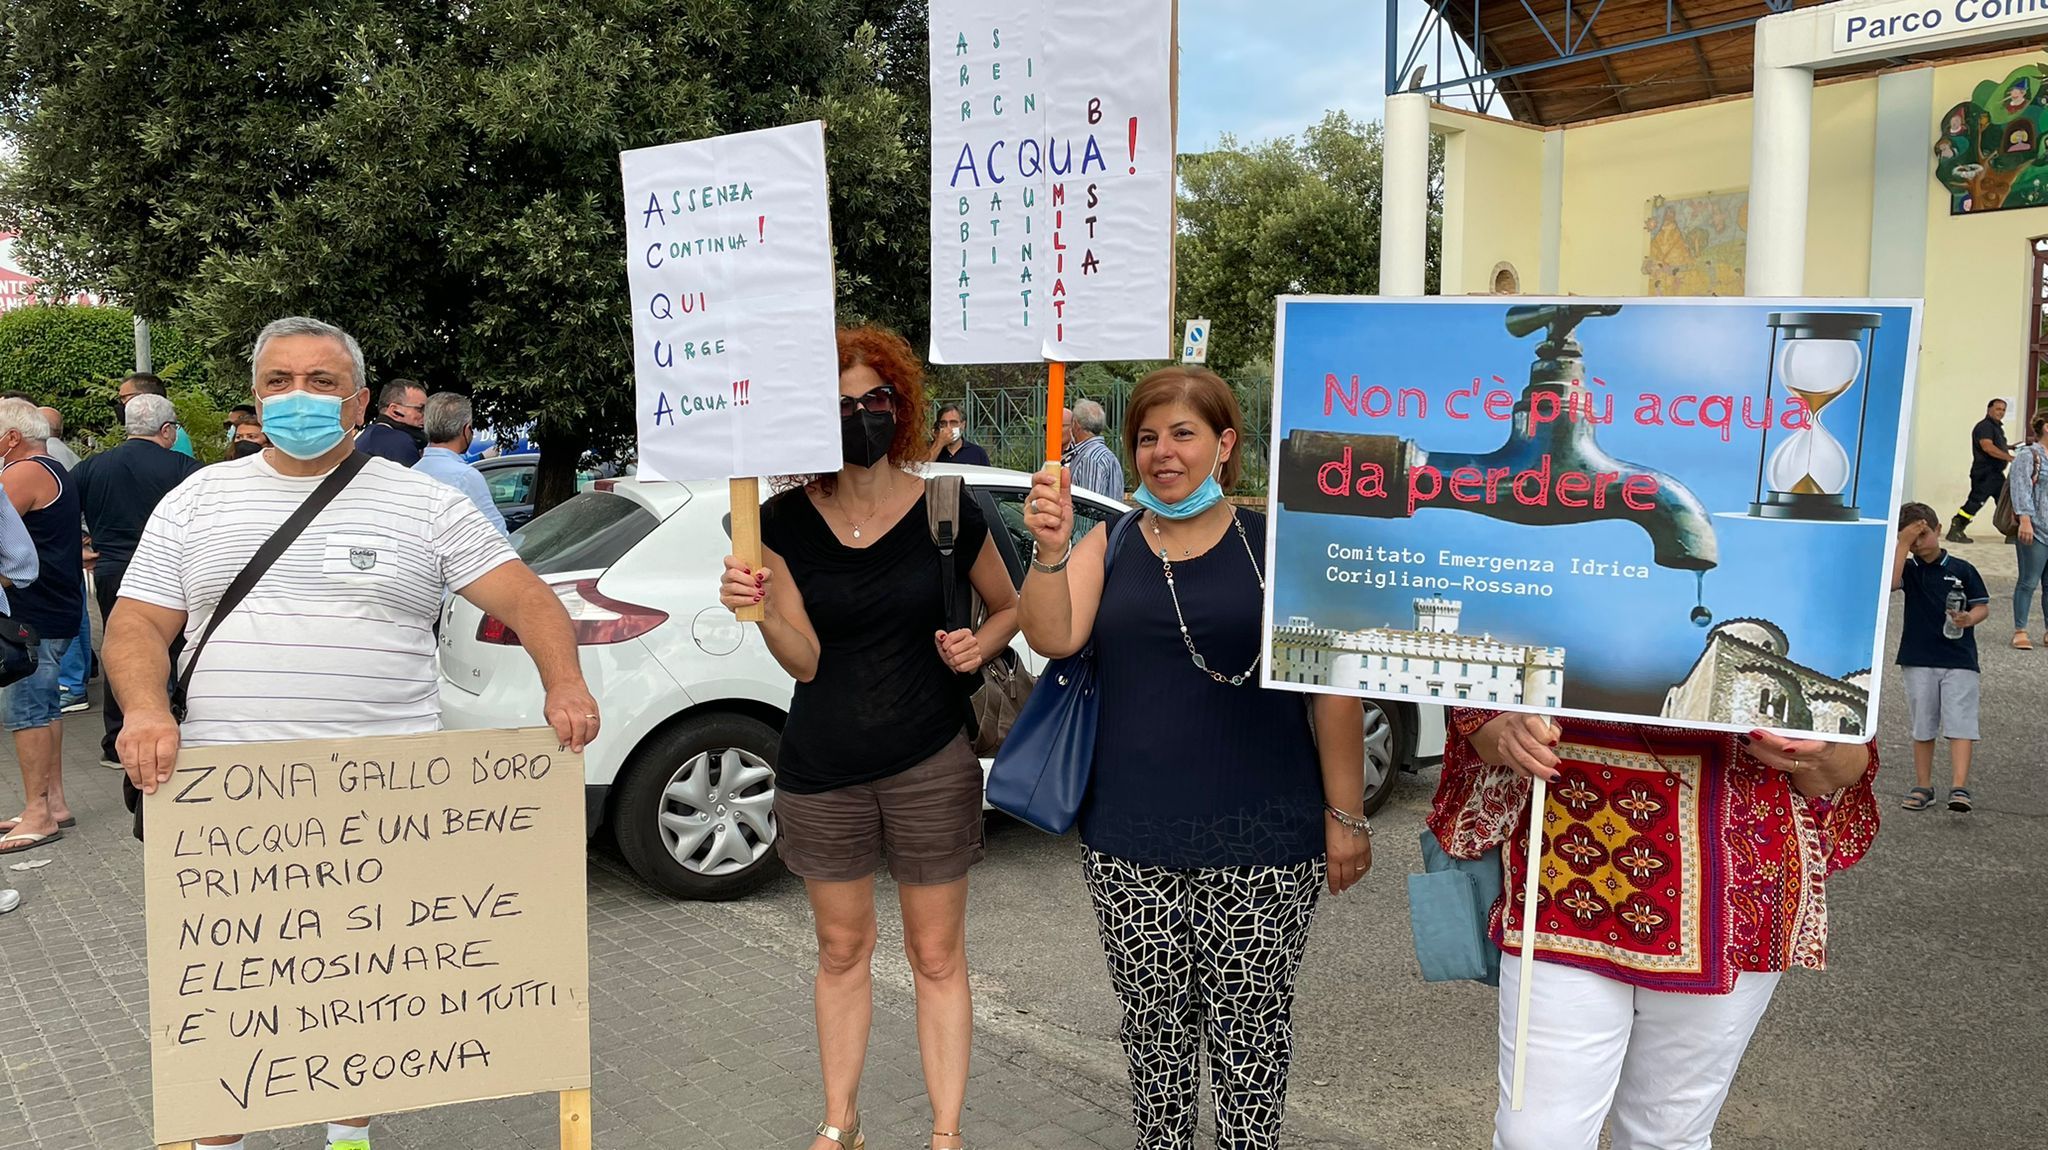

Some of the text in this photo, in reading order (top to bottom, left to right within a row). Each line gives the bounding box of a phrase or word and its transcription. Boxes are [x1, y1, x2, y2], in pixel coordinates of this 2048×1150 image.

[1847, 9, 1942, 42] Parco
[643, 181, 753, 229] ASSENZA
[650, 291, 706, 320] QUI
[653, 339, 726, 368] URGE
[1323, 373, 1812, 442] Non c'è più acqua
[1317, 446, 1660, 516] da perdere
[1326, 566, 1553, 597] Corigliano-Rossano
[1327, 543, 1649, 579] Comitato Emergenza Idrica
[173, 764, 317, 803] ZONA
[174, 818, 326, 858] L'ACQUA
[378, 813, 431, 845] UN
[442, 805, 542, 836] BENE
[176, 858, 383, 899] PRIMARIO
[179, 883, 523, 950] NON LA SI DEVE
[179, 940, 500, 997] ELEMOSINARE
[230, 1005, 279, 1038] UN
[297, 993, 427, 1033] DIRITTO
[440, 990, 467, 1016] DI
[477, 980, 558, 1016] TUTTI
[220, 1039, 491, 1110] VERGOGNA
